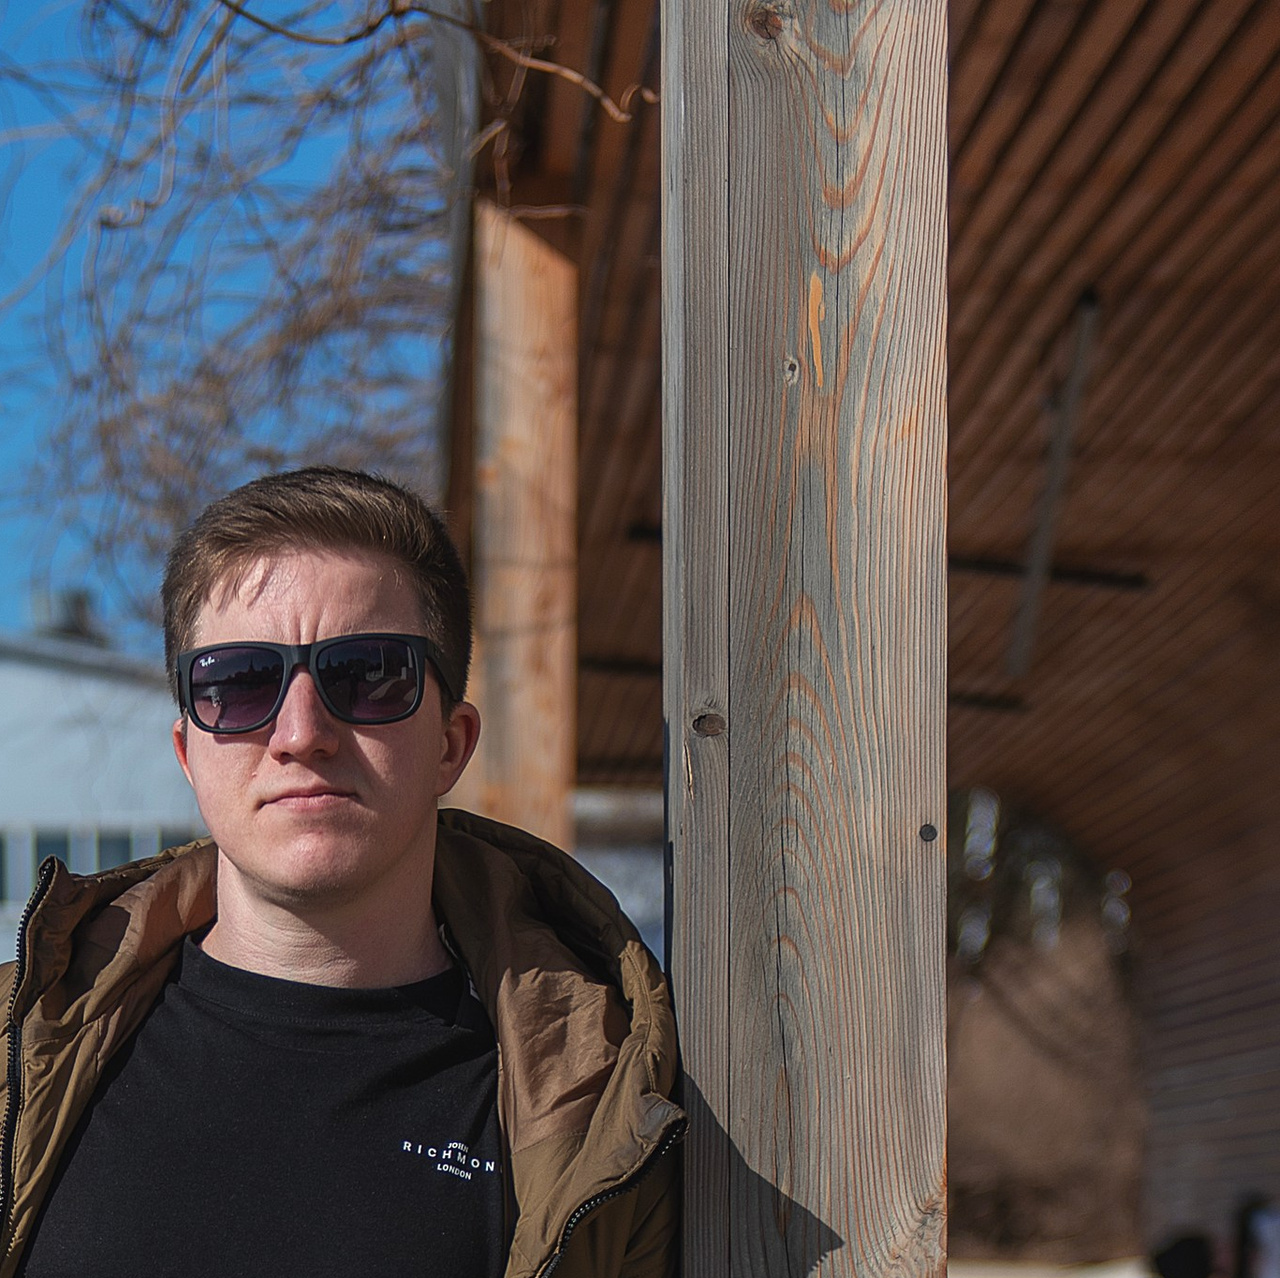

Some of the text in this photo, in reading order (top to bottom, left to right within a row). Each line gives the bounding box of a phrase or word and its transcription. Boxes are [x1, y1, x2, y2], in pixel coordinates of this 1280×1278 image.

[447, 1142, 469, 1153] JOHN
[403, 1141, 502, 1173] RICHMON
[437, 1163, 472, 1180] LONDON
